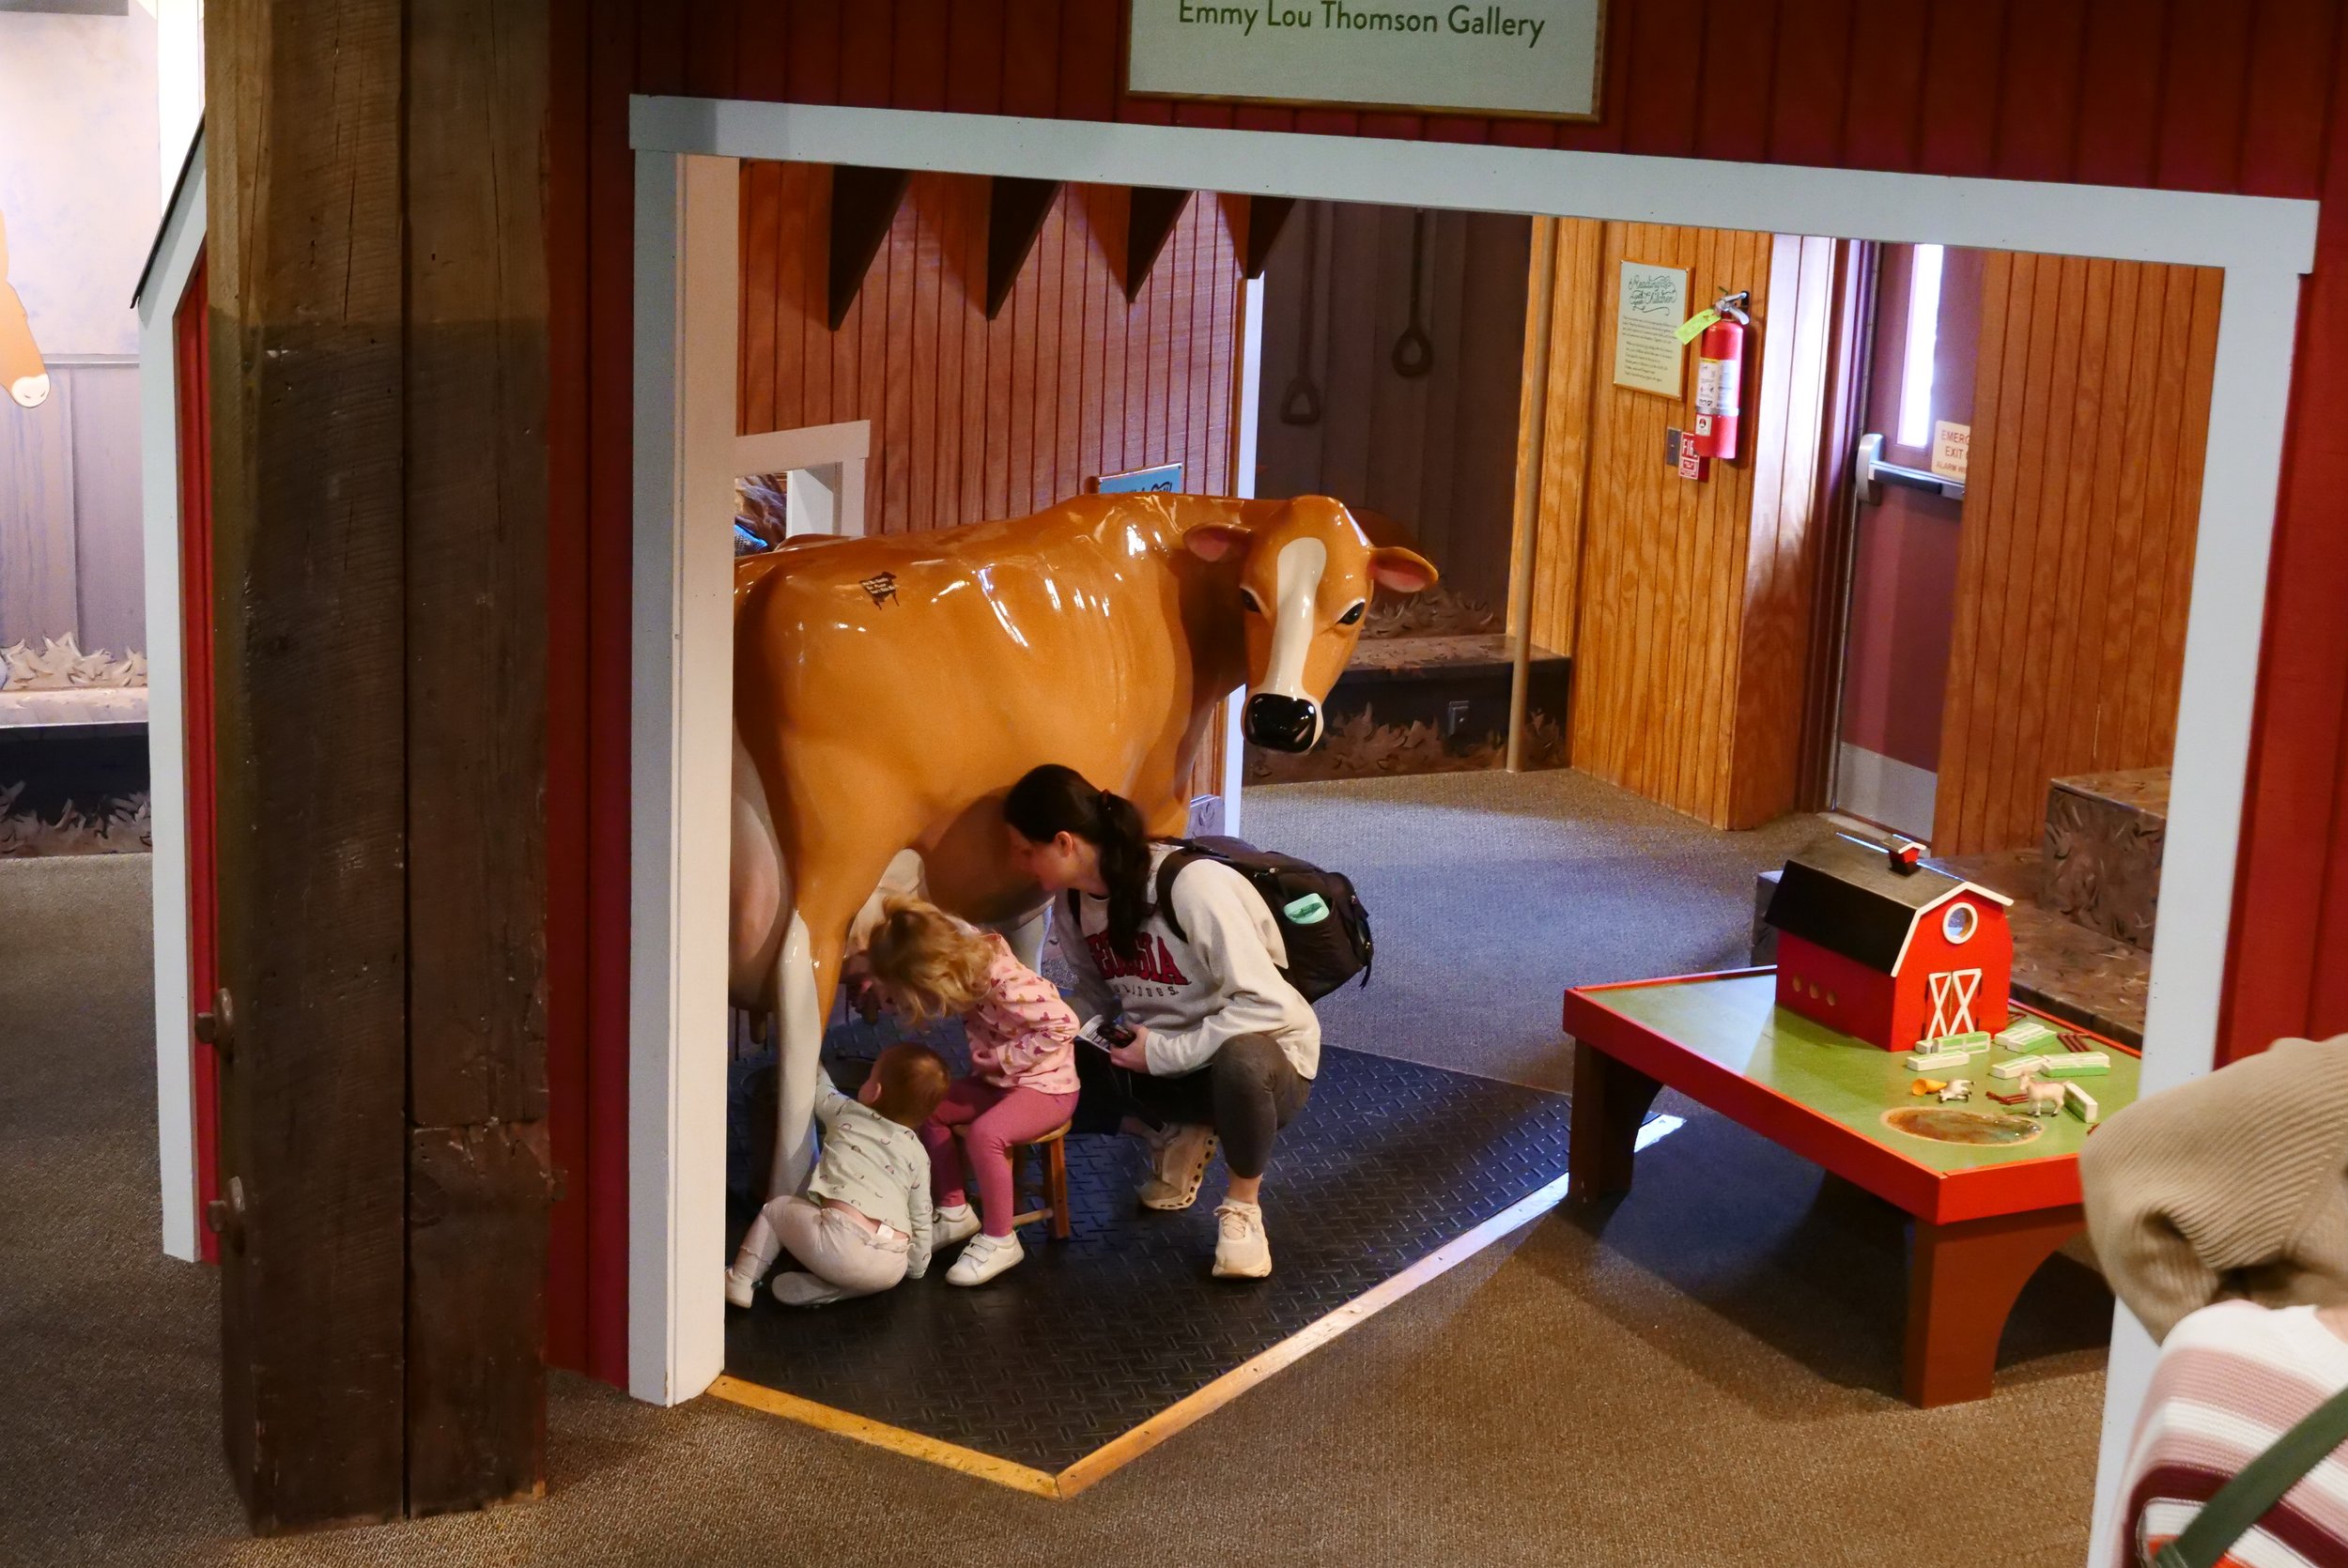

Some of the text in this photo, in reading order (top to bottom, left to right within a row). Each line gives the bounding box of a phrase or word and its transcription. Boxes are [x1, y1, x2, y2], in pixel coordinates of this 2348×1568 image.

[1180, 0, 1545, 48] Emmy Lou Thomson Gallery
[1945, 446, 1964, 459] EXIT
